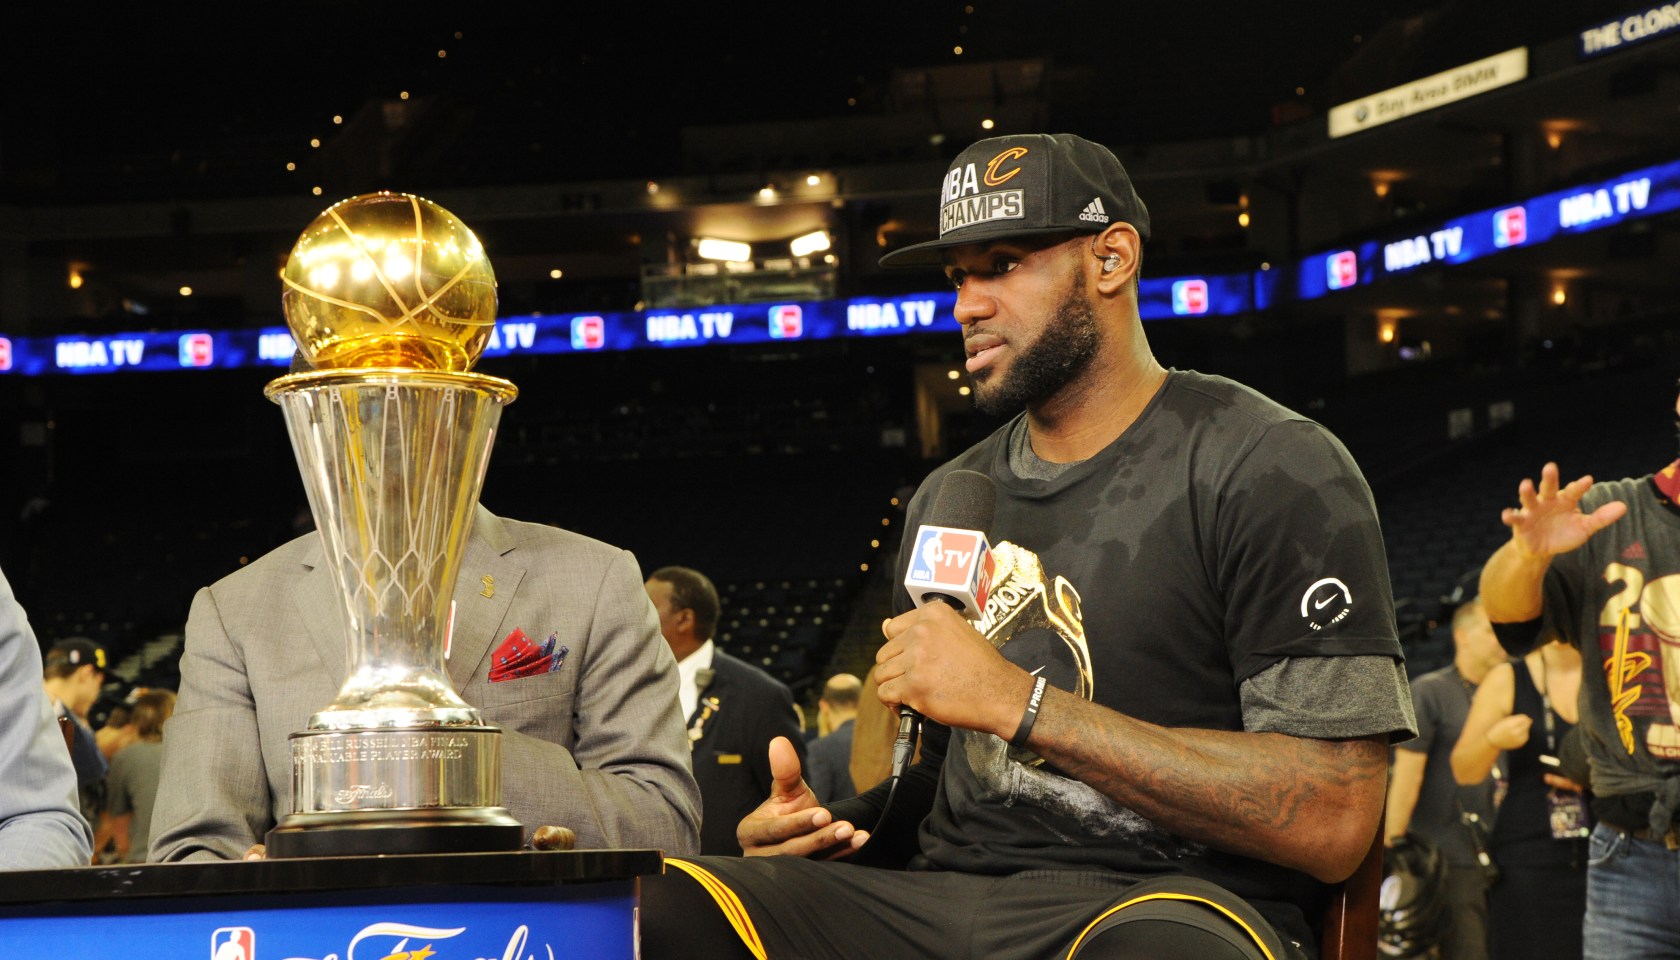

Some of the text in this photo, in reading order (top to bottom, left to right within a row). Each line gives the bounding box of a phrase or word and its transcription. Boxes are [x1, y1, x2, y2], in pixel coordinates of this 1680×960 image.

[1581, 21, 1621, 54] THE
[1375, 99, 1405, 118] Bay
[1411, 84, 1450, 103] Area
[941, 163, 979, 206] NBA
[942, 193, 1020, 231] CHAMPS
[1078, 211, 1109, 223] adidas
[1559, 177, 1651, 229] NBA TV
[1384, 226, 1463, 272] NBA TV
[647, 312, 734, 341] NBA TV
[847, 300, 936, 330] NBA TV
[502, 323, 536, 349] TV
[56, 339, 144, 367] NBA TV
[944, 549, 972, 568] TV
[912, 569, 930, 580] NBA
[346, 737, 399, 750] RUSSELL
[430, 736, 469, 748] FINALS
[370, 749, 418, 762] PLAYER
[420, 748, 462, 761] AWARD
